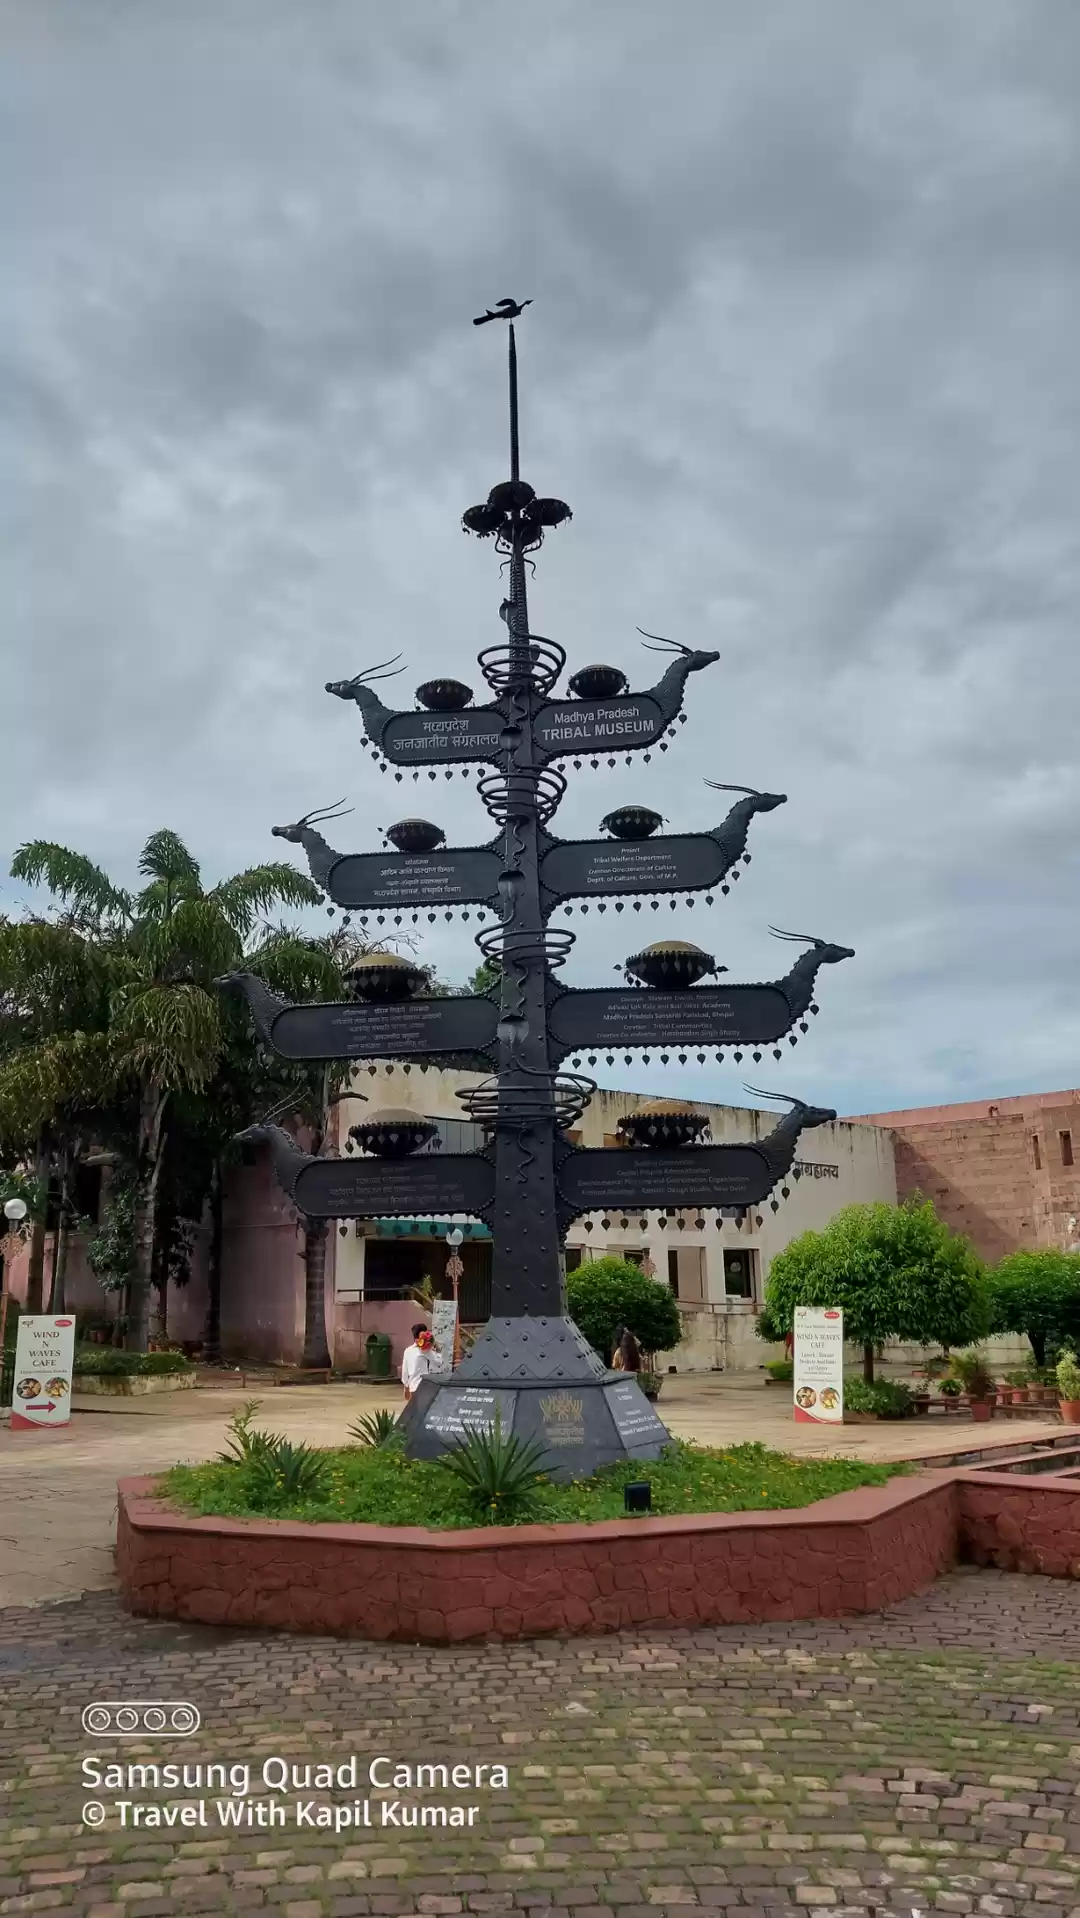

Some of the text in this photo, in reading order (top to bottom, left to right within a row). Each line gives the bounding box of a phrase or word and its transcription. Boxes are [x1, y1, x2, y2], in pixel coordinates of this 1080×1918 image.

[554, 706, 640, 724] Madhya Pradesh
[542, 720, 654, 740] TRIBAL MUSEUM
[393, 732, 499, 750] जनजातीय संग्रहालय
